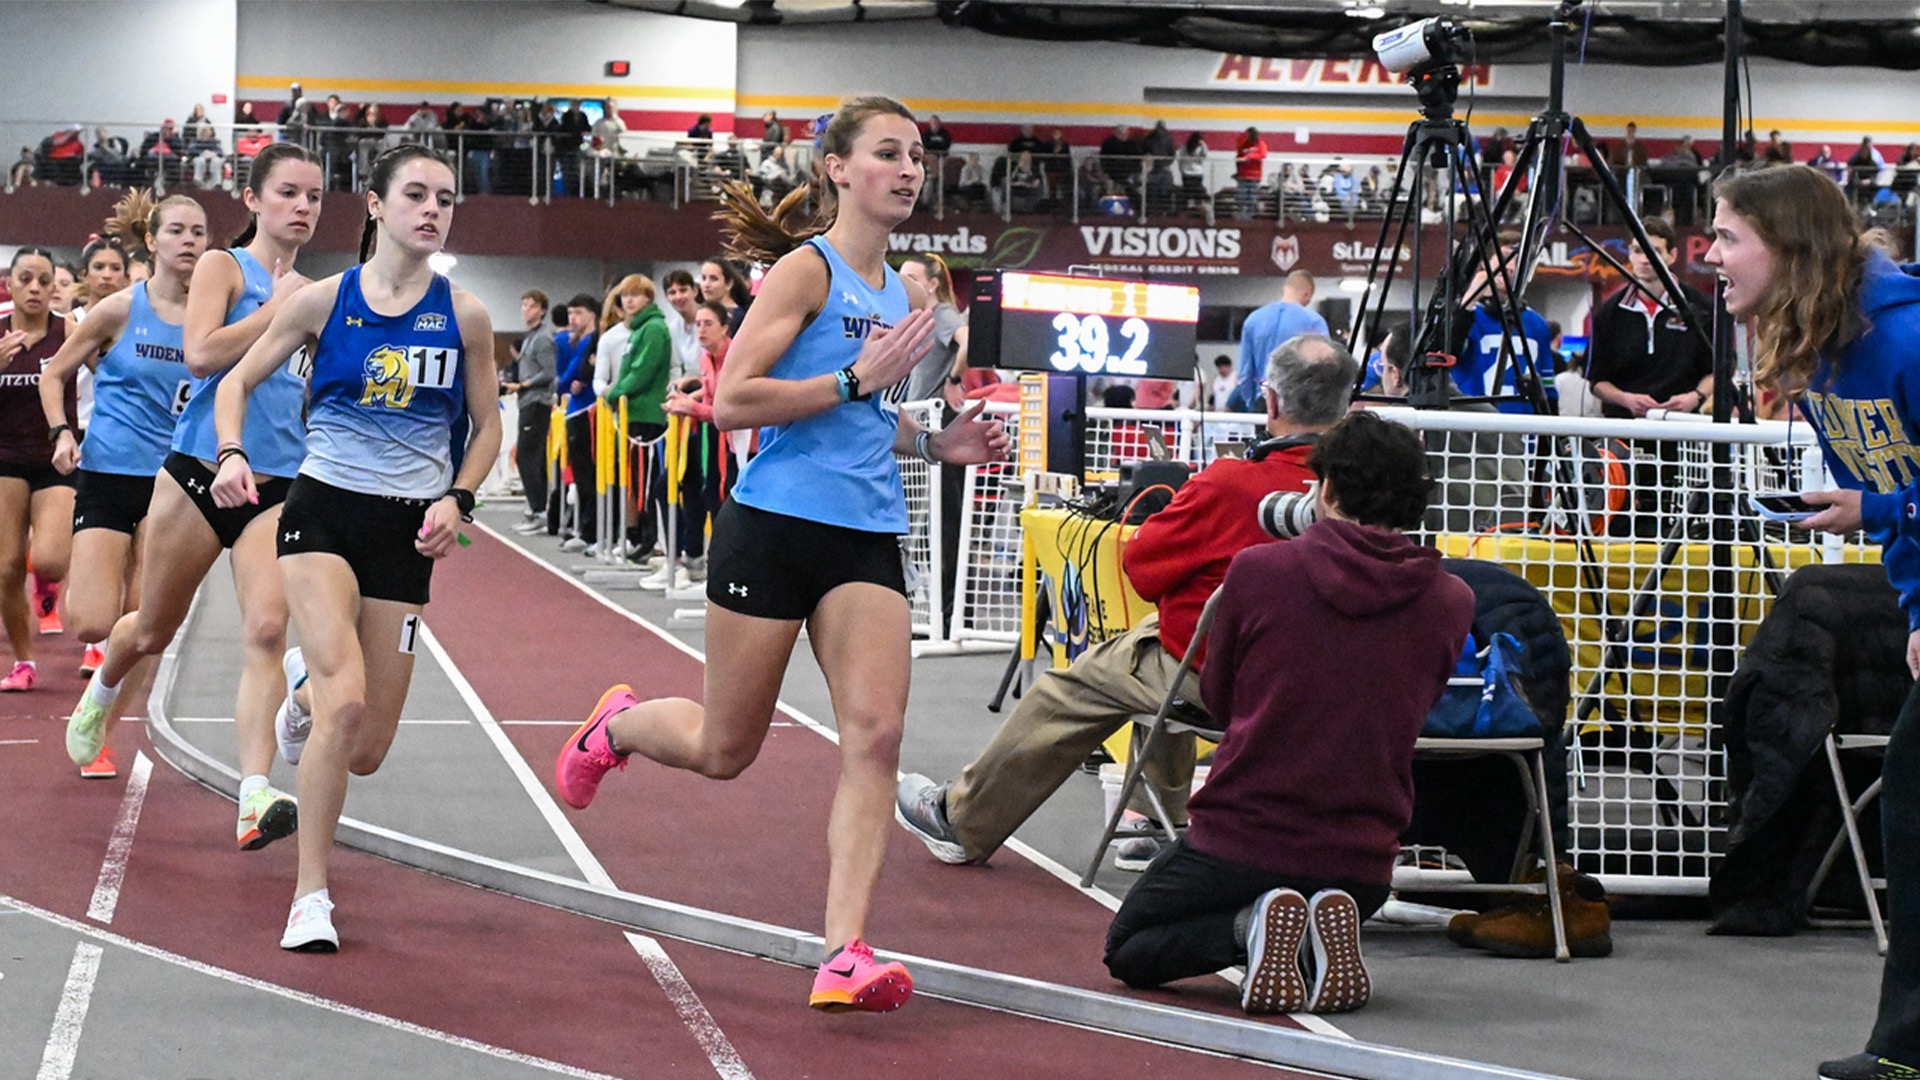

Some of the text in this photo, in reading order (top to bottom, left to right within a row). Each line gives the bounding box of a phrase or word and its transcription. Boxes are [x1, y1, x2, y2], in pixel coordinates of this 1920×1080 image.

[1080, 226, 1241, 259] VISIONS
[417, 320, 444, 330] MAC
[1050, 312, 1149, 375] 39.2
[413, 349, 447, 386] 11
[407, 616, 418, 652] 1
